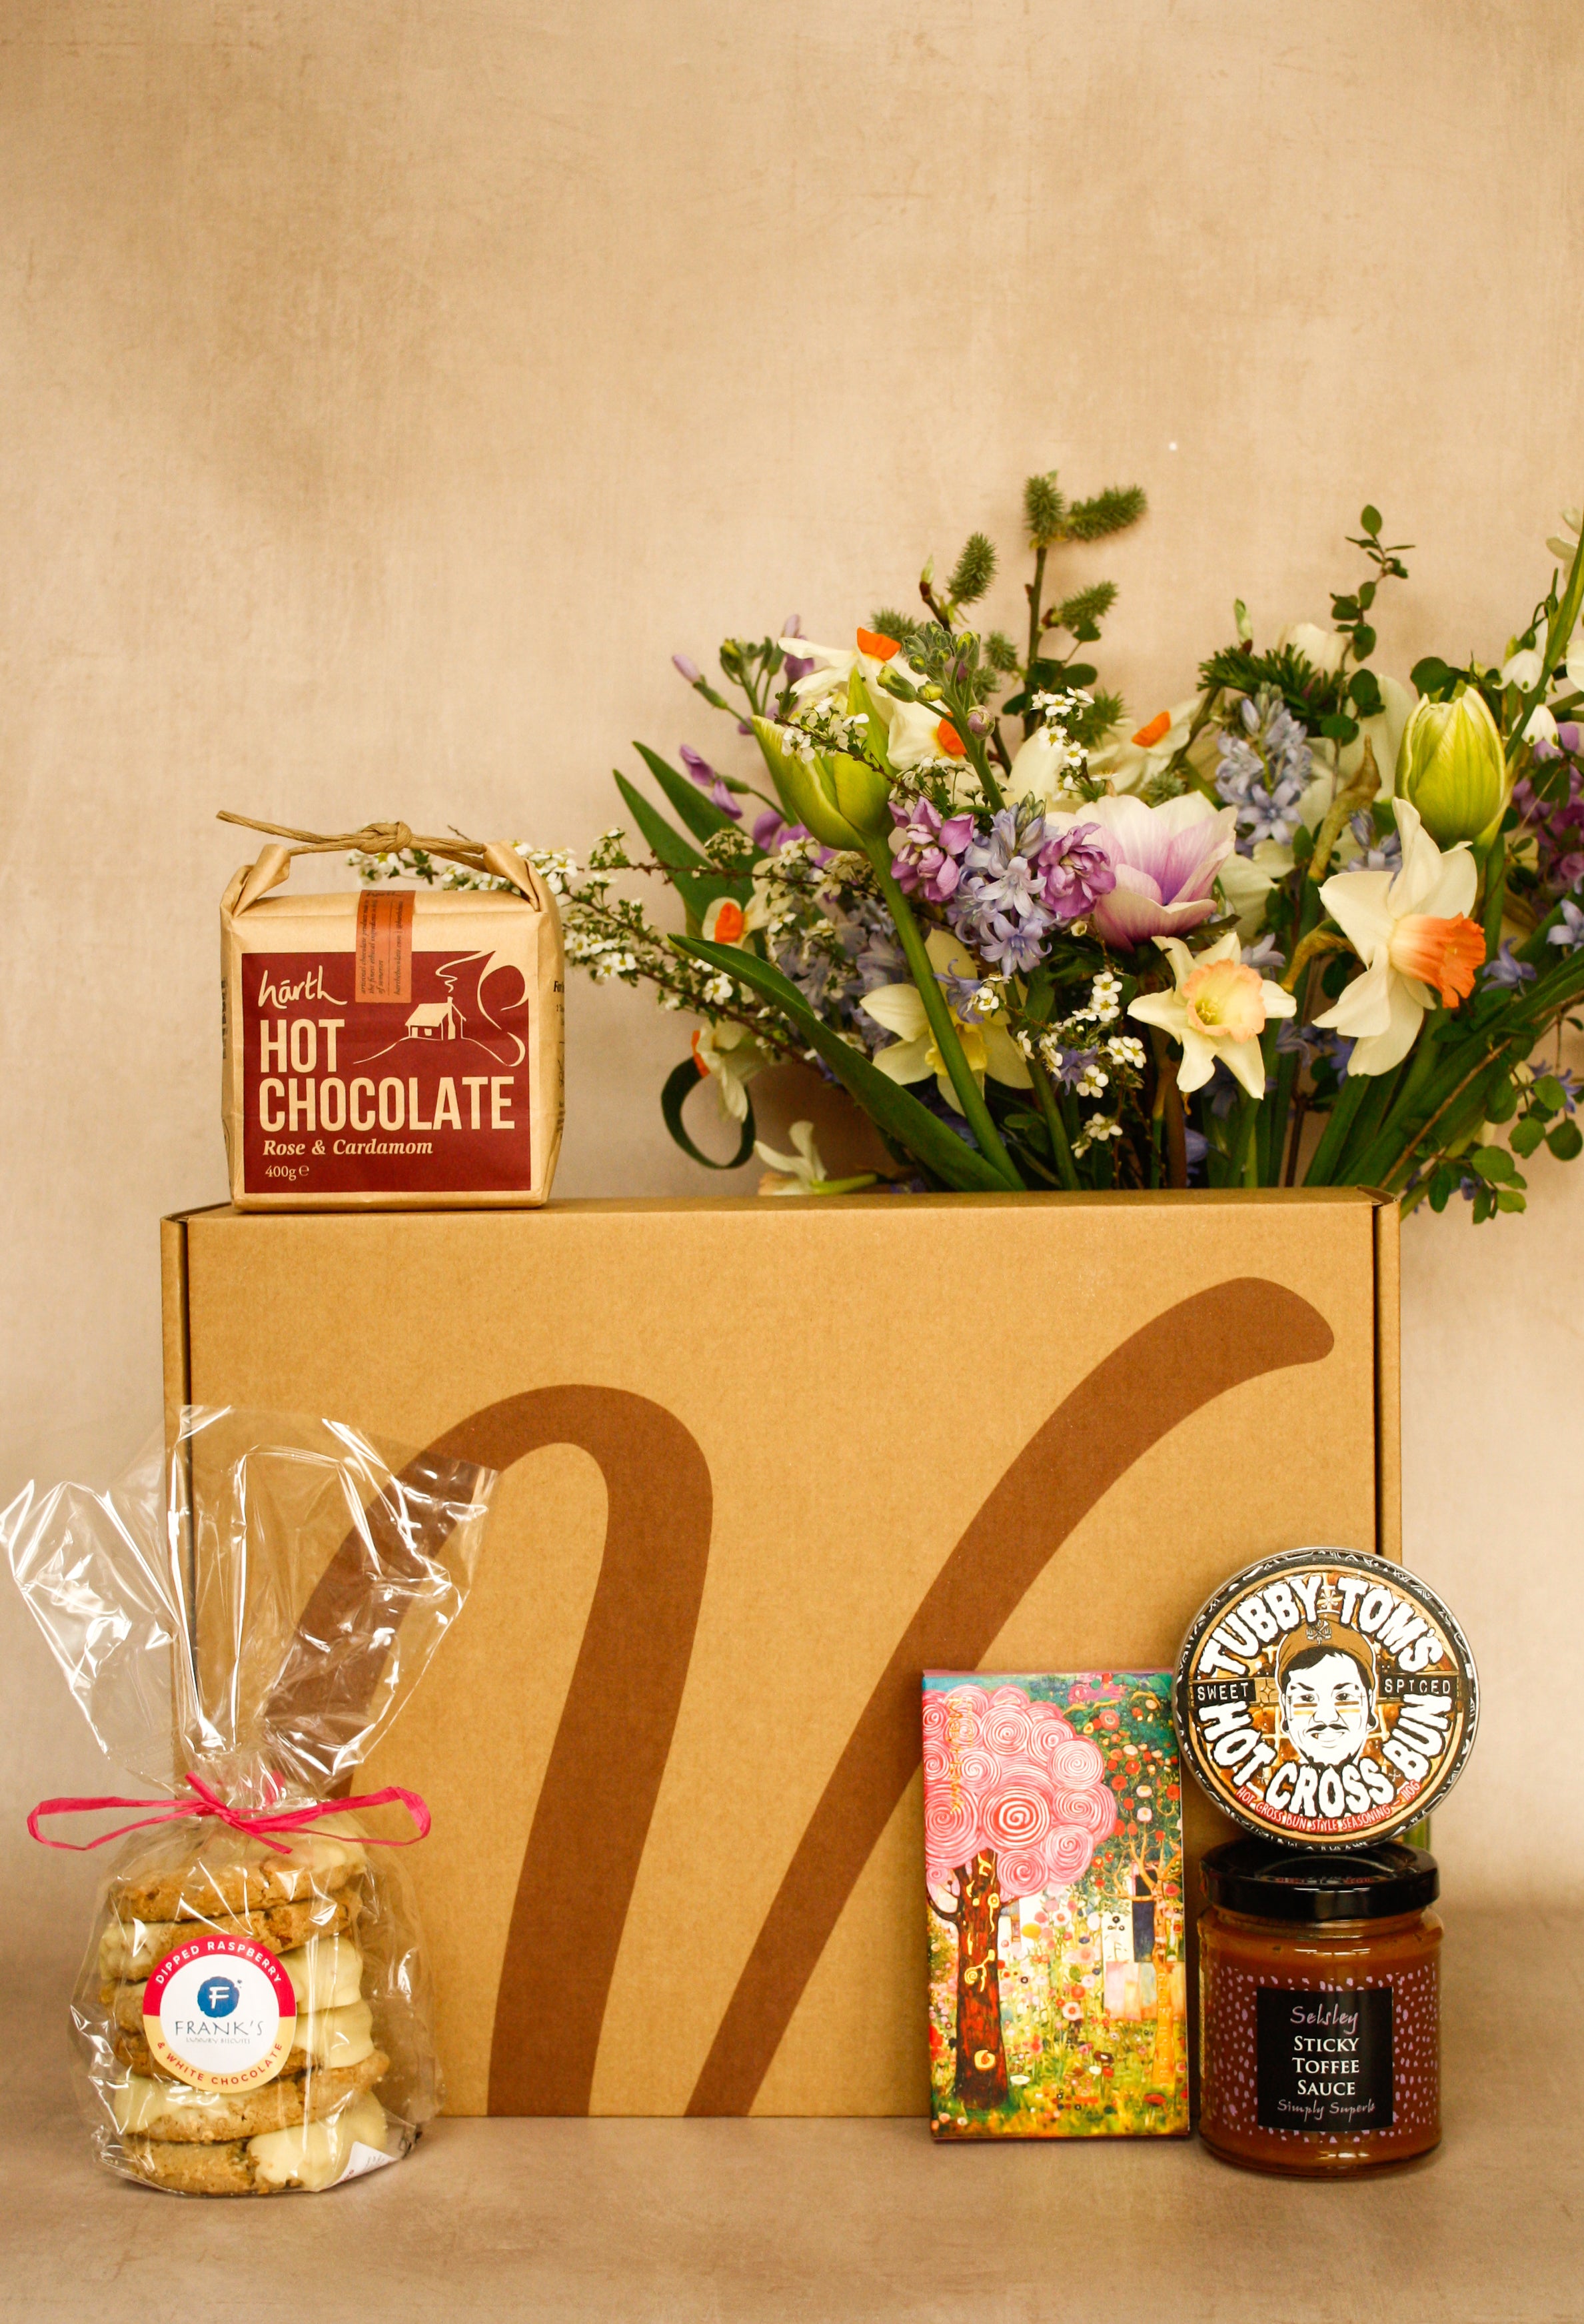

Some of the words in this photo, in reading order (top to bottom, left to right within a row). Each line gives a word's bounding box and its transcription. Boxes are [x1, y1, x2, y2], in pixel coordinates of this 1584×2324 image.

[260, 1019, 345, 1073] HOT
[259, 1076, 515, 1132] CHOCOLATE
[263, 1140, 305, 1156] Rose
[312, 1140, 326, 1156] &
[333, 1139, 433, 1156] Cardamom
[265, 1164, 297, 1182] 400g
[1198, 1575, 1323, 1676] TUBBY
[1334, 1576, 1444, 1673] TOM'S
[1197, 1682, 1248, 1701] SWEET
[1383, 1678, 1451, 1695] SPICED
[1199, 1701, 1276, 1787] HOT
[1265, 1757, 1395, 1817] CROSS
[1382, 1694, 1453, 1782] BUN
[1236, 1786, 1256, 1804] HOT
[1255, 1802, 1283, 1822] CROSS
[1286, 1813, 1308, 1829] BUN
[1310, 1819, 1338, 1832] STYLE
[1341, 1804, 1391, 1830] SEASONING
[1402, 1781, 1421, 1801] 110G
[155, 1945, 200, 1984] DIPPED
[207, 1941, 282, 1983] RASPBERRY
[175, 2020, 264, 2035] FRANK'S
[1290, 2003, 1359, 2034] Selsley
[1293, 2035, 1359, 2052] STICKY
[166, 2053, 204, 2081] WHITE
[211, 2043, 283, 2085] CHOCOLATE
[1291, 2057, 1360, 2073] TOFFEE
[1297, 2079, 1356, 2095] SAUCE
[1277, 2099, 1325, 2121] Simply
[1329, 2099, 1375, 2122] Superb
